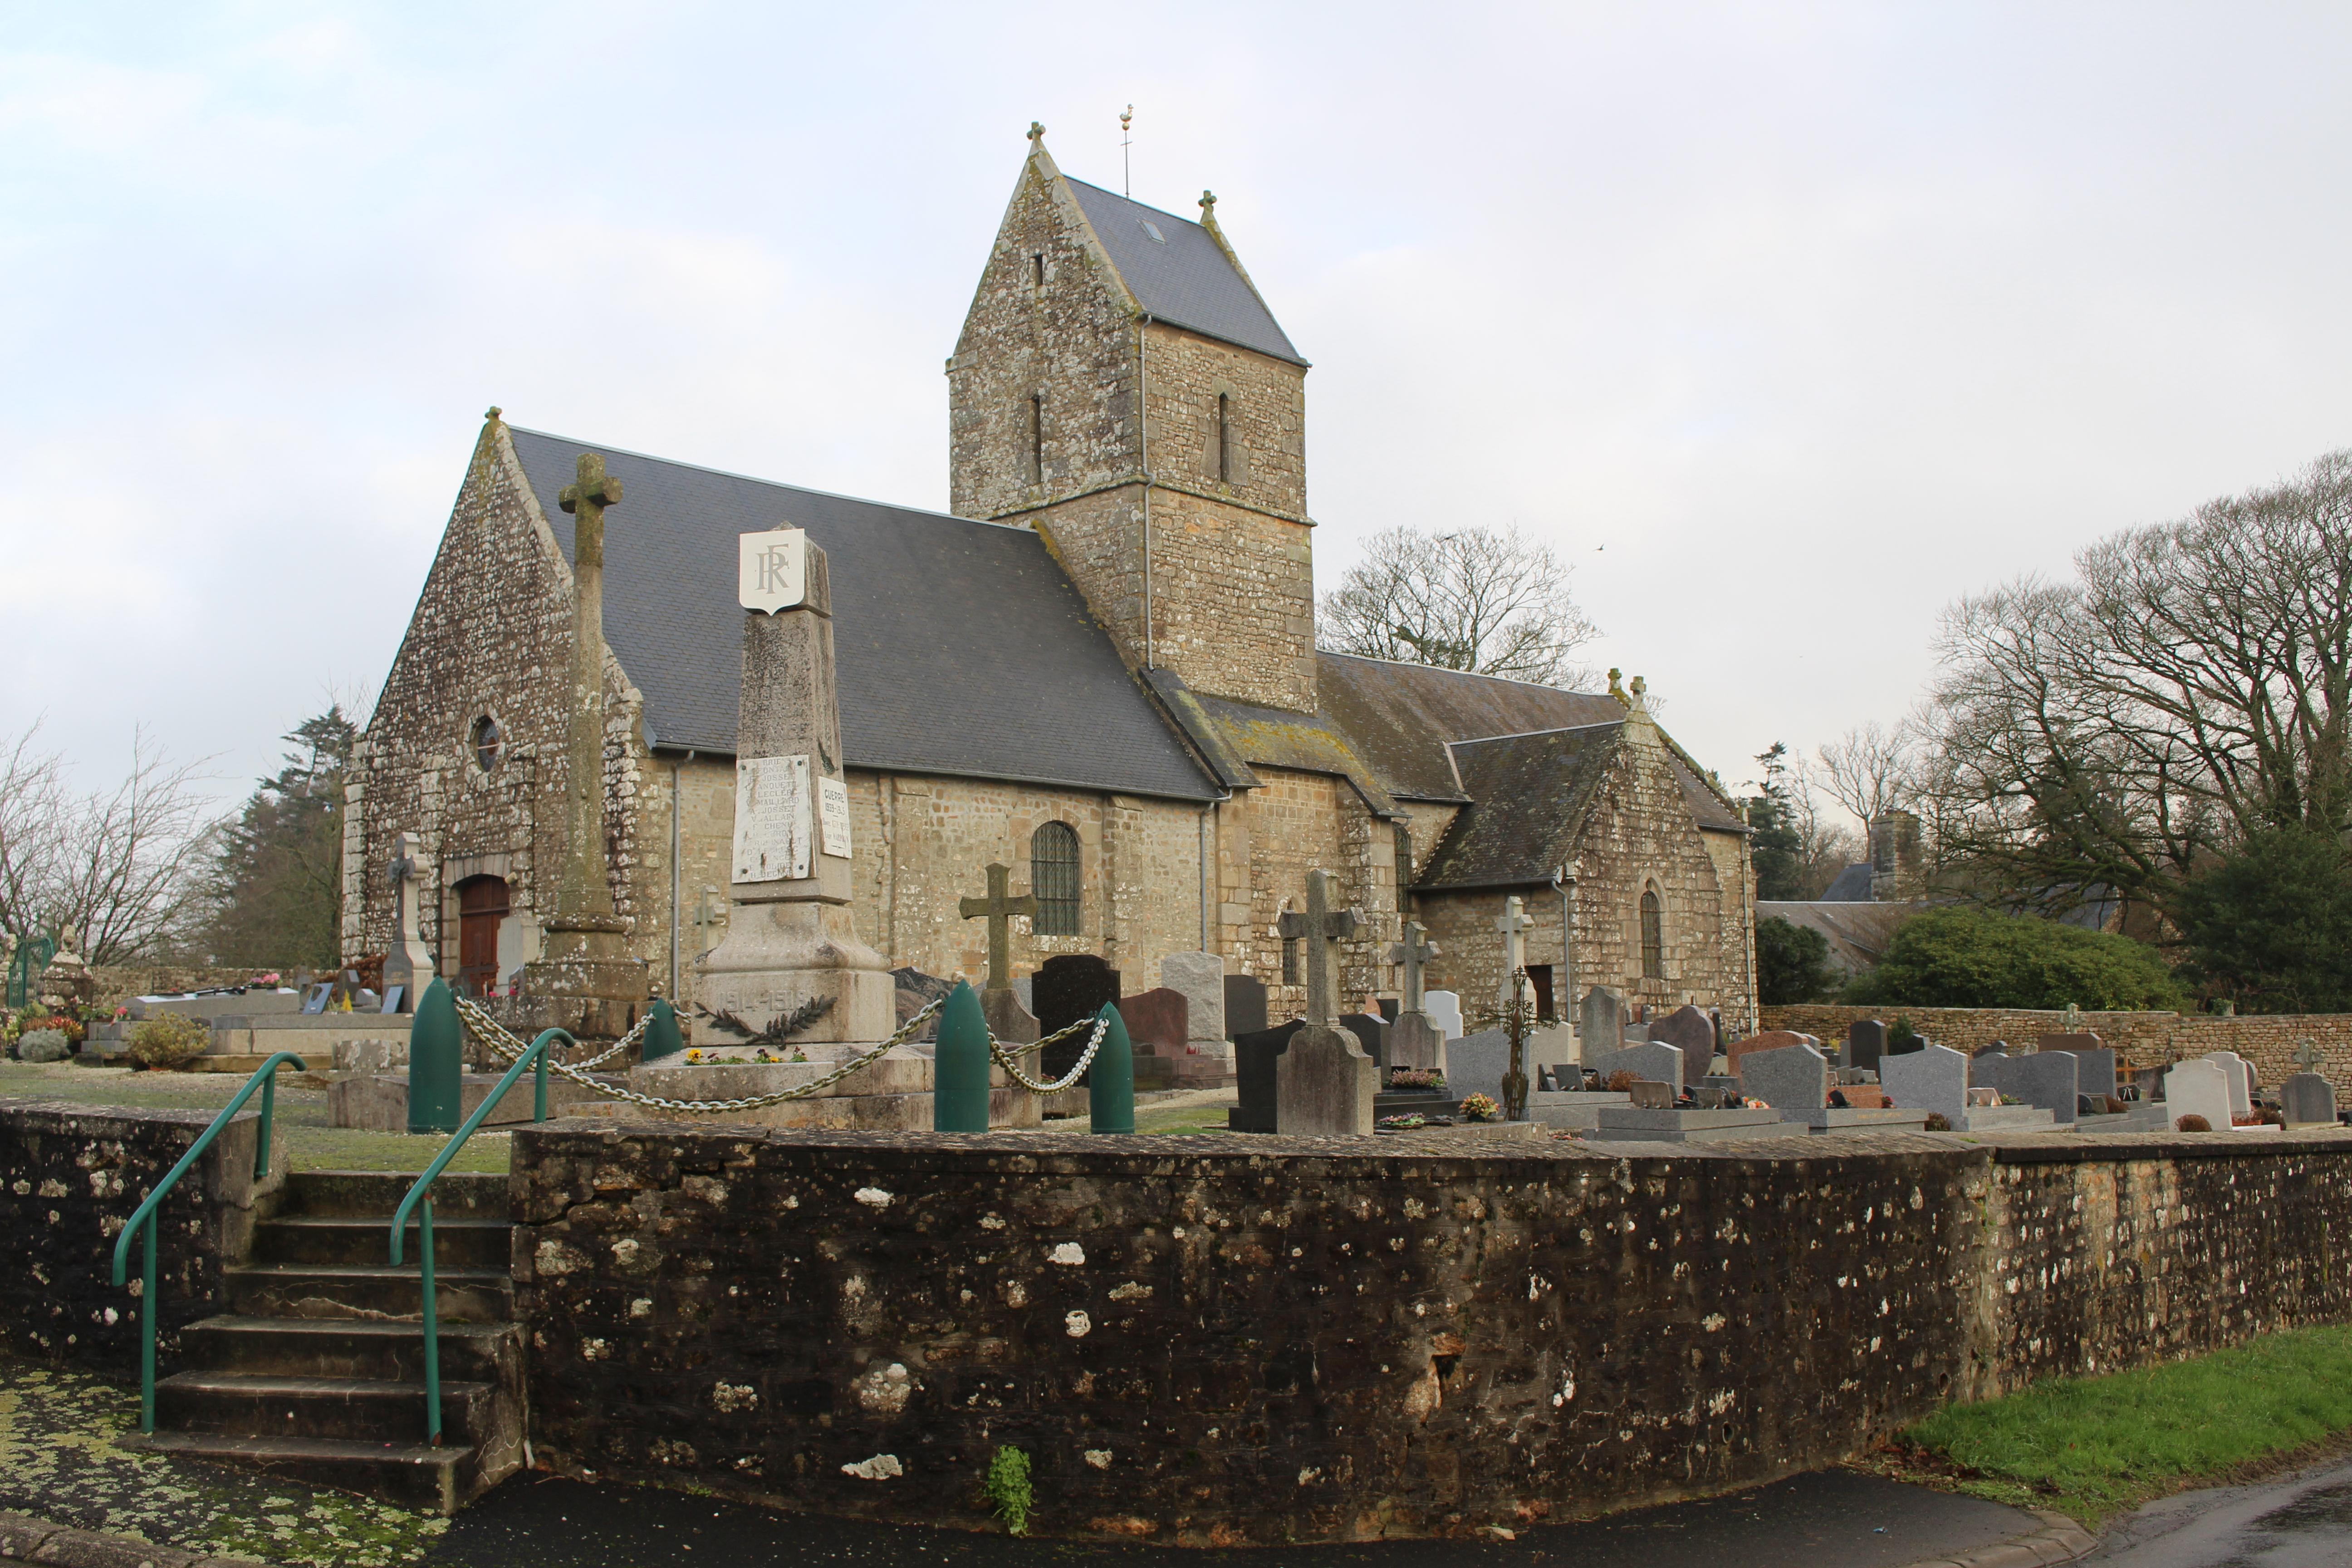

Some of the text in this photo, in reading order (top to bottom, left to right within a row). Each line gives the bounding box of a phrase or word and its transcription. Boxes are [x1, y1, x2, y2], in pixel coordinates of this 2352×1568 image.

[762, 773, 795, 782] JOSSET
[824, 789, 844, 803] GUERRE
[763, 805, 796, 814] JOSSET
[764, 813, 794, 822] ALLAIN
[720, 989, 807, 1012] 1914-1918
